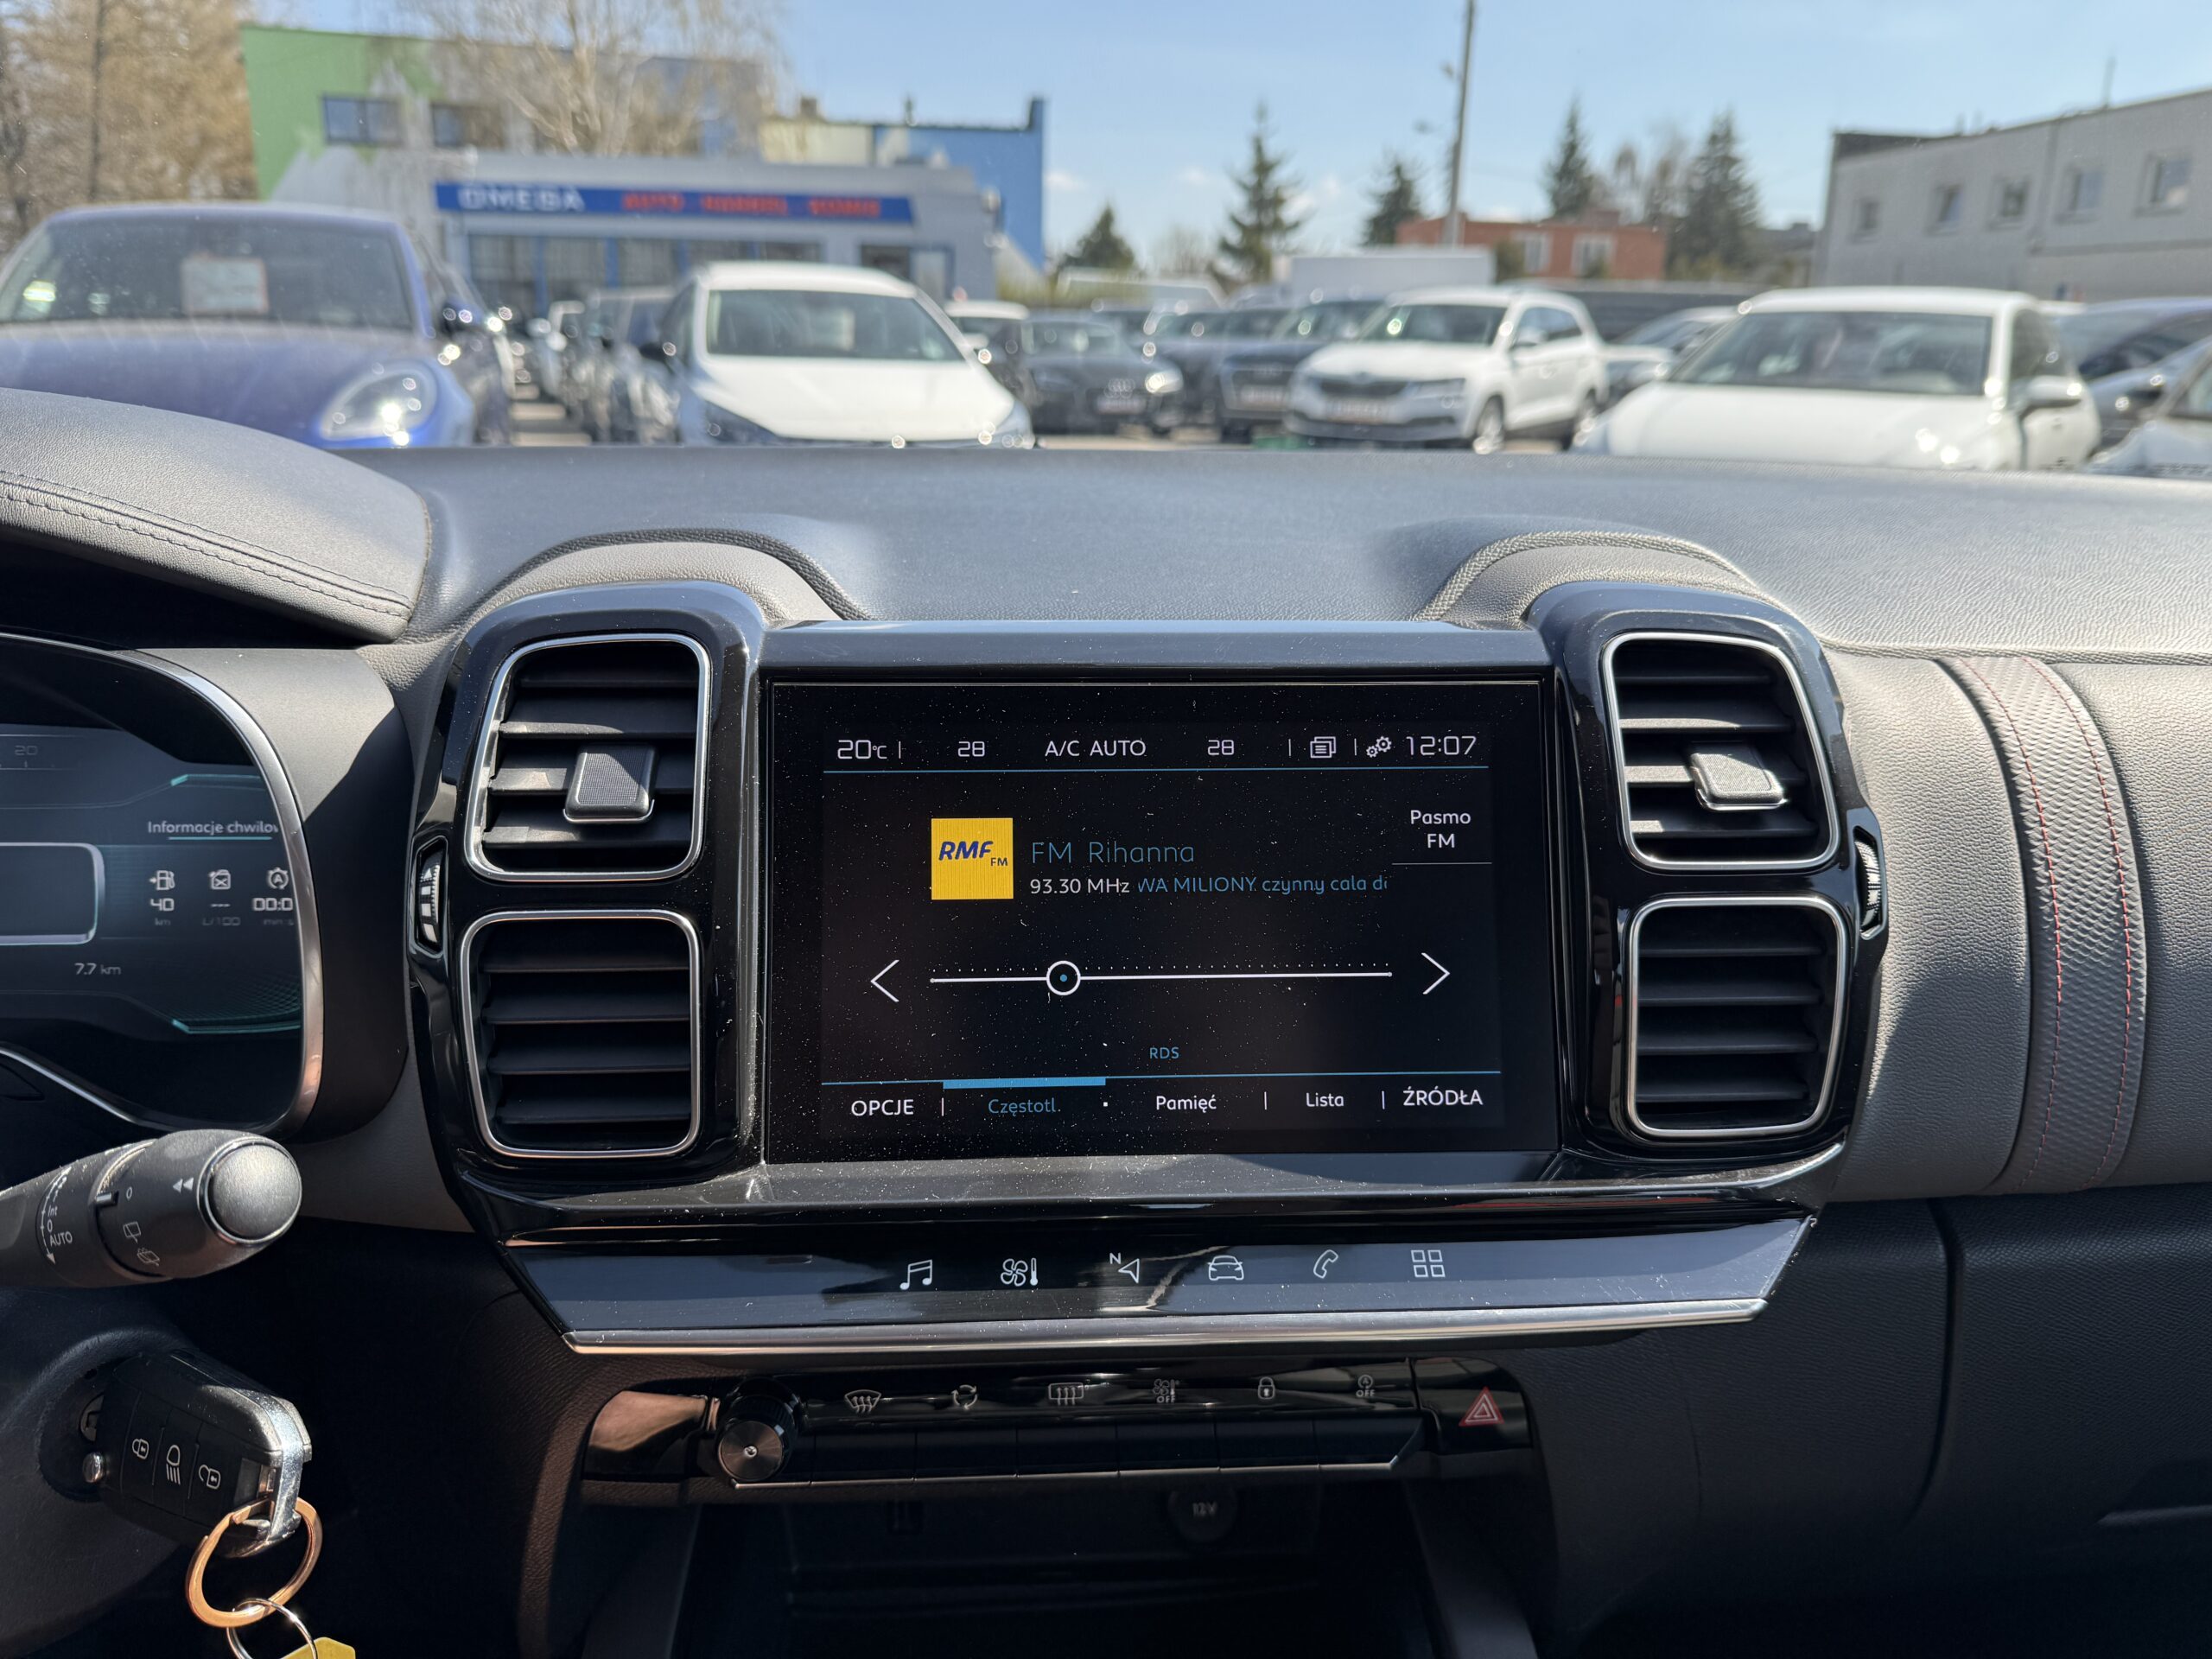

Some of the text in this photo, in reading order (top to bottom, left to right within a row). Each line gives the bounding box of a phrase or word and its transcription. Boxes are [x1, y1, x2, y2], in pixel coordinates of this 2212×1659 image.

[957, 741, 986, 758] 28
[1045, 740, 1147, 758] A/C AUTO
[1207, 739, 1236, 756] 28
[1406, 735, 1478, 756] 12:07
[1409, 810, 1471, 825] Pasmo
[148, 821, 224, 836] Informacje
[1427, 833, 1456, 849] FM
[938, 841, 995, 861] RMF
[1032, 840, 1195, 864] FM Rihanna
[990, 857, 1008, 868] FM
[1030, 878, 1082, 894] 93.30
[1087, 878, 1130, 893] MHz
[1137, 877, 1169, 893] WA
[1173, 876, 1258, 893] MILIONY
[1262, 877, 1325, 895] czynny
[1330, 875, 1367, 892] cala
[150, 898, 175, 912] 40
[154, 918, 172, 927] km
[74, 963, 122, 976] 7.7 km
[1149, 1046, 1180, 1060] RDS
[1155, 1094, 1217, 1114] Pamięć
[1306, 1092, 1345, 1108] Lista
[1402, 1085, 1484, 1107] ŹRÓDŁA
[851, 1099, 915, 1117] OPCJE
[49, 1230, 73, 1246] AUTO
[1109, 1252, 1122, 1265] N
[1156, 1395, 1176, 1403] OFF
